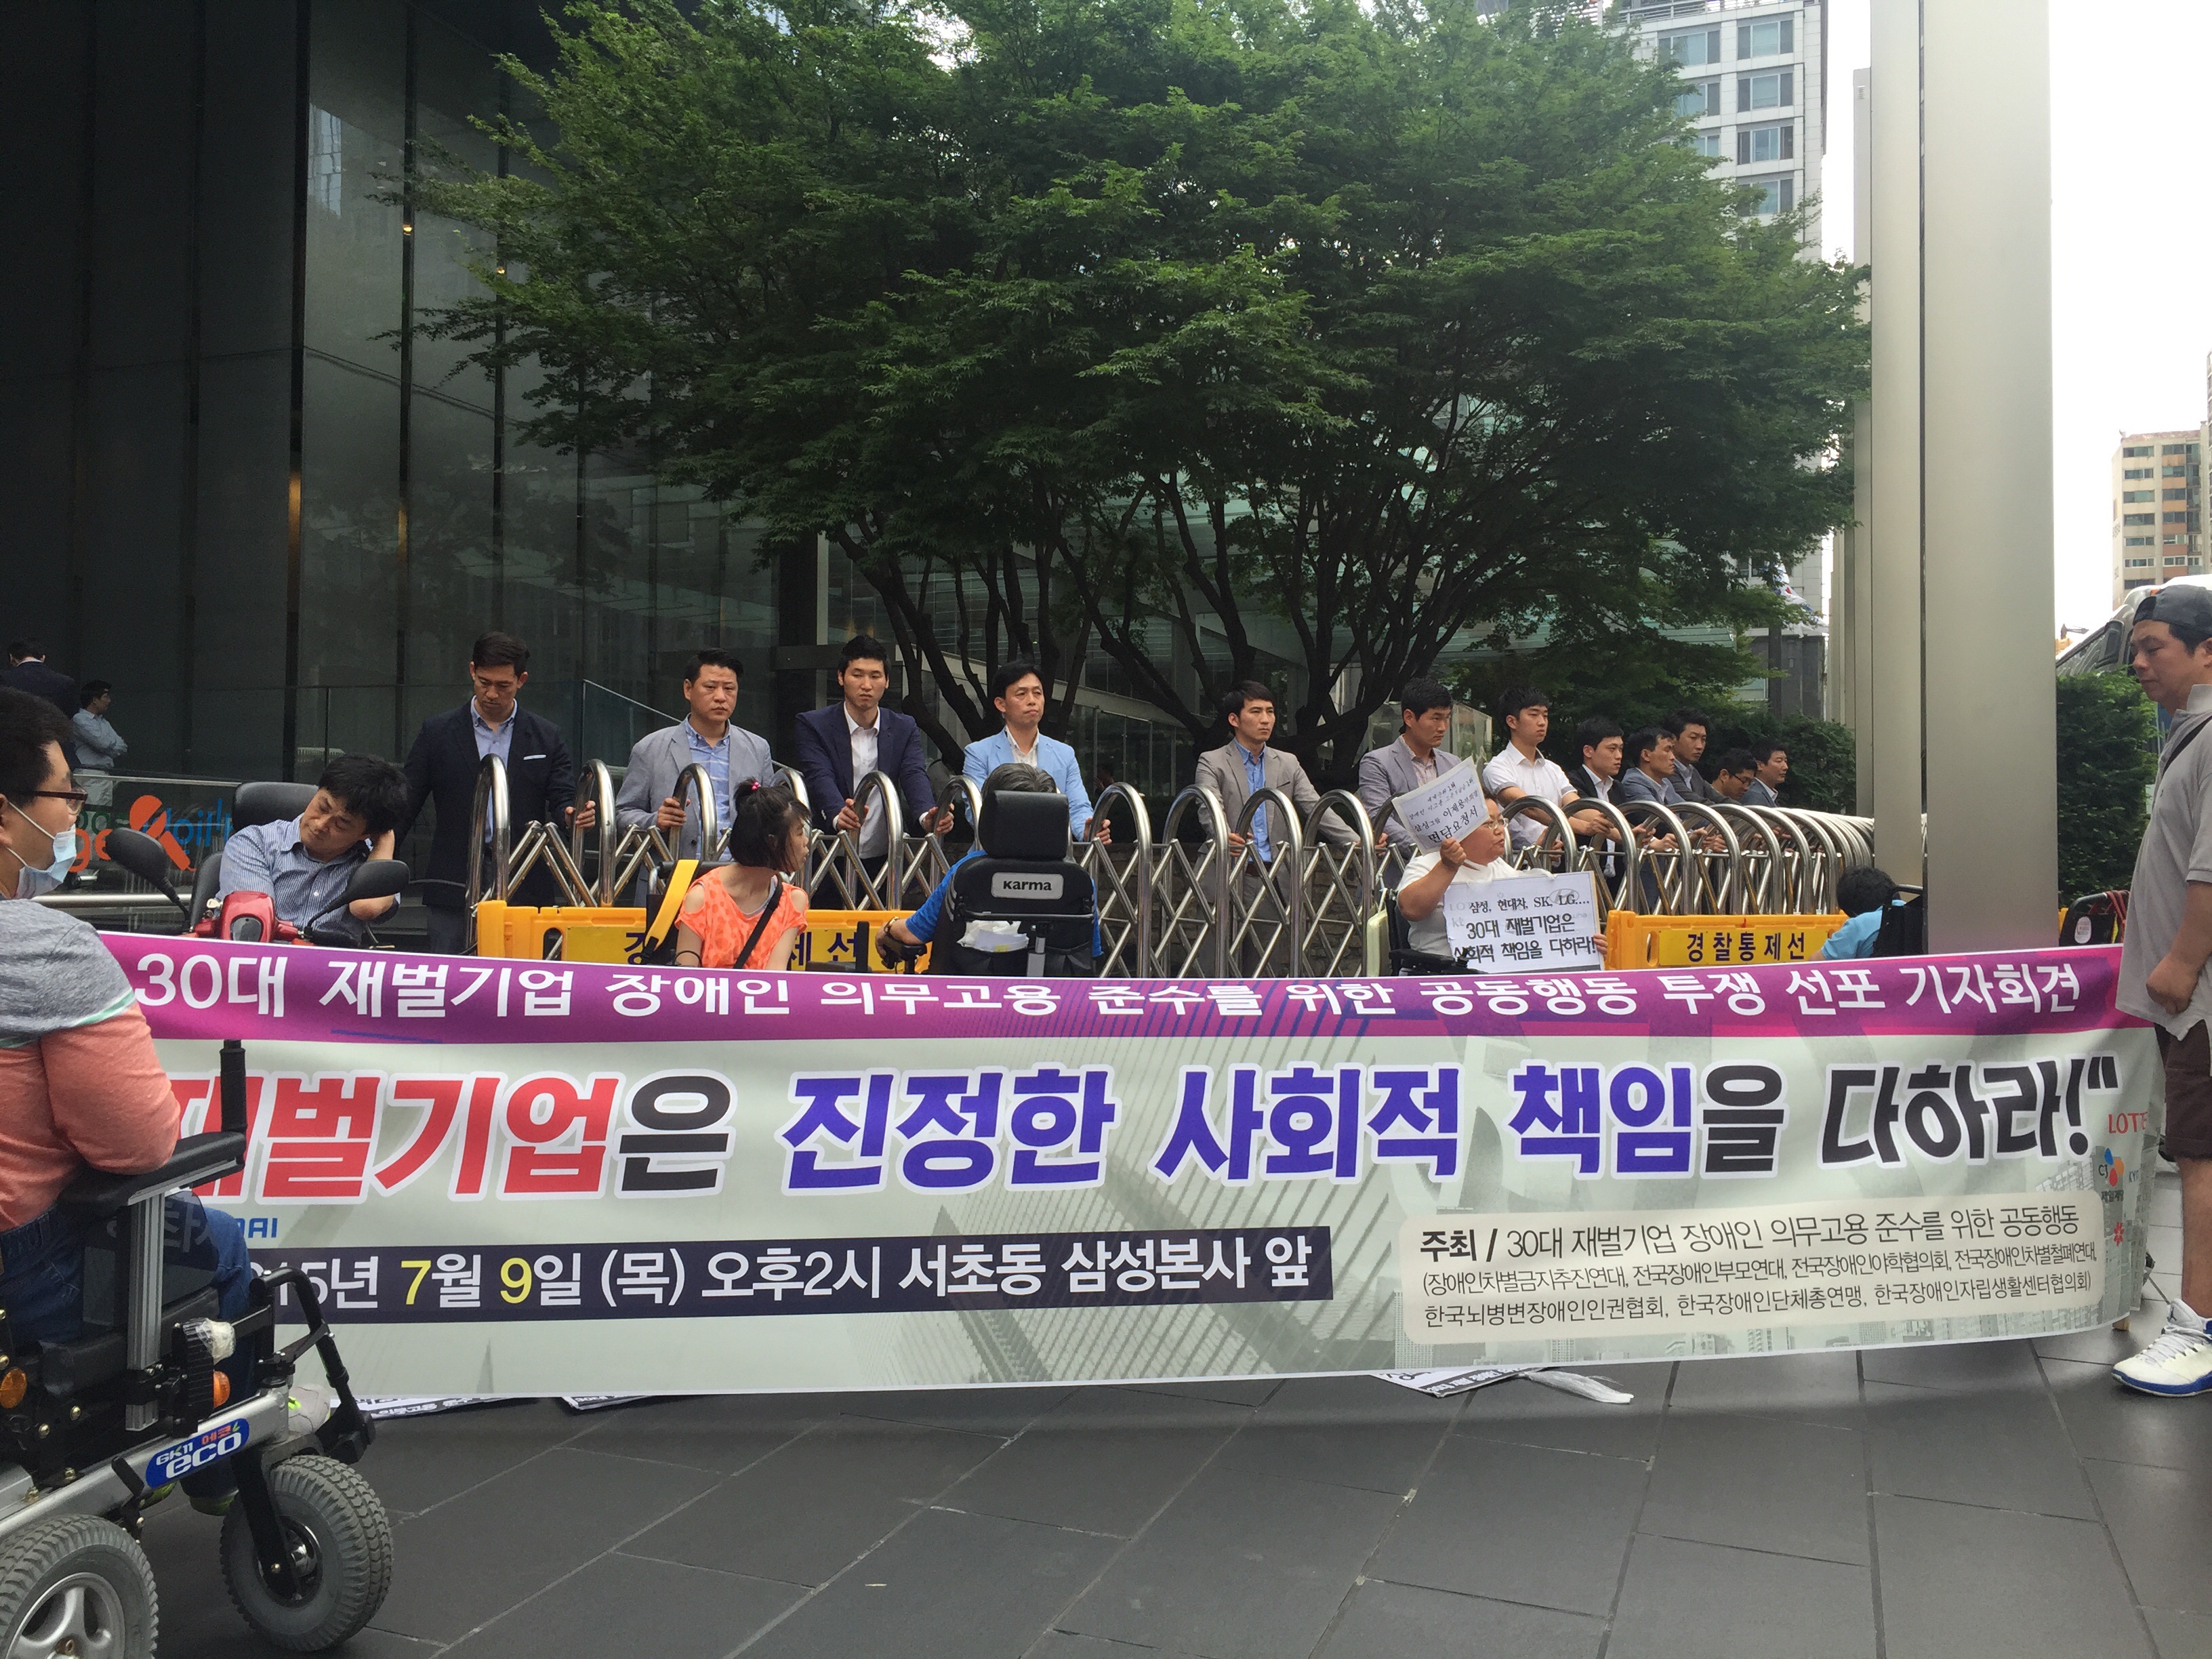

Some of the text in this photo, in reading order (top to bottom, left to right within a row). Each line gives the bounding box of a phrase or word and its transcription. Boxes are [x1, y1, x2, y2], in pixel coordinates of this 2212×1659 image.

[1003, 880, 1052, 891] karma
[1470, 901, 1492, 914] 삼성,
[1497, 897, 1528, 911] 현대차,
[1534, 896, 1553, 907] SK,
[1466, 913, 1575, 939] 30대 재벌기업은
[1501, 940, 1543, 960] 책임을
[1549, 936, 1596, 956] 다하라!
[1687, 933, 1805, 962] 경찰통제선
[136, 954, 2080, 1017] 30대 재벌기업 장애인 의무고용 준수를 위한 공동행동 투쟁 선포 기자회견
[783, 1069, 1115, 1189] 진정한
[1155, 1067, 1459, 1180] 사회적
[1509, 1065, 1784, 1174] 책임을
[1420, 1229, 1477, 1263] 주최
[1507, 1227, 1563, 1258] 30대
[1571, 1225, 1676, 1257] 재벌기업
[1681, 1219, 1763, 1254] 장애인
[1771, 1214, 1868, 1247] 의무고용
[1875, 1212, 1944, 1243] 준수를
[1950, 1209, 1994, 1239] 위한
[2000, 1205, 2079, 1237] 공동행동
[401, 1253, 481, 1308] 7월
[499, 1252, 581, 1306] 9일
[601, 1249, 686, 1307] (목)
[701, 1246, 880, 1298] 오후2시
[898, 1244, 1046, 1297] 서초동
[1061, 1237, 1251, 1293] 삼성본사
[1265, 1235, 1313, 1287] 앞
[1423, 1266, 1629, 1296] (장애인차별금지추진연대,
[1633, 1258, 1788, 1288] 전국장애인부모연대,
[1791, 1250, 1952, 1279] 전국장애인야학협의회,
[1425, 1271, 2092, 1328] 한국뇌병변장애인인권협회, 한국장애인단체총연맹, 한국장애인자립생활센터협의회)
[156, 1442, 193, 1465] GK11
[166, 1432, 242, 1479] eco
